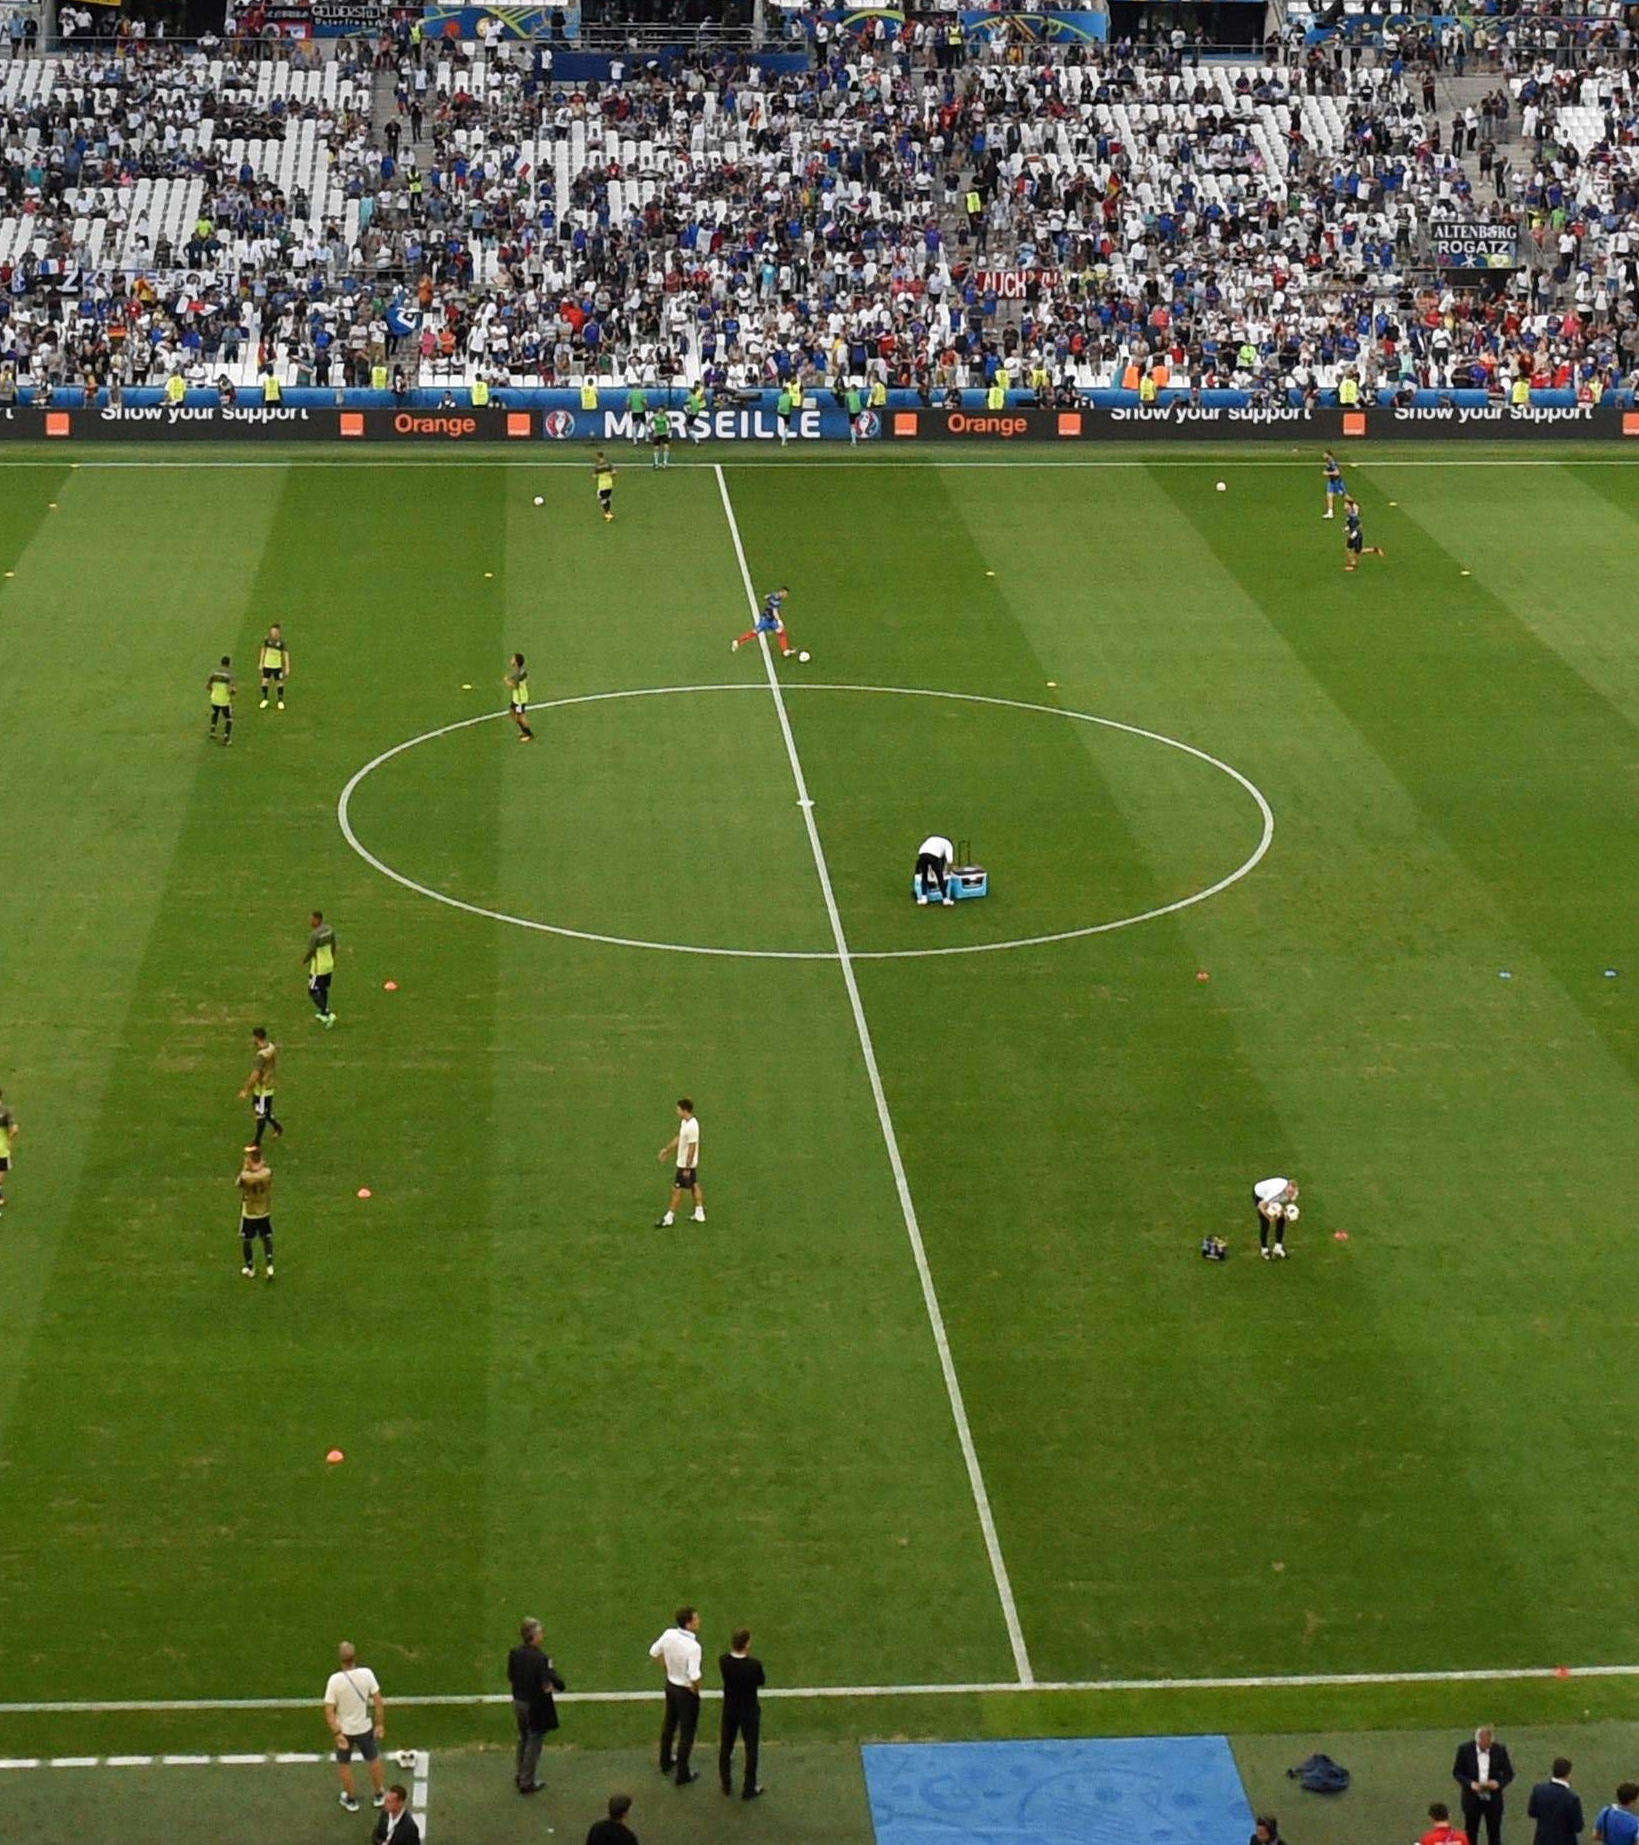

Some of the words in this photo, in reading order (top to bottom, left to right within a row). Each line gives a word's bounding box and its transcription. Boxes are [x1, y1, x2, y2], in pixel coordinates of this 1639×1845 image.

[394, 413, 476, 437] Orange
[603, 410, 821, 439] MRSEILLE
[948, 413, 1028, 437] Orange
